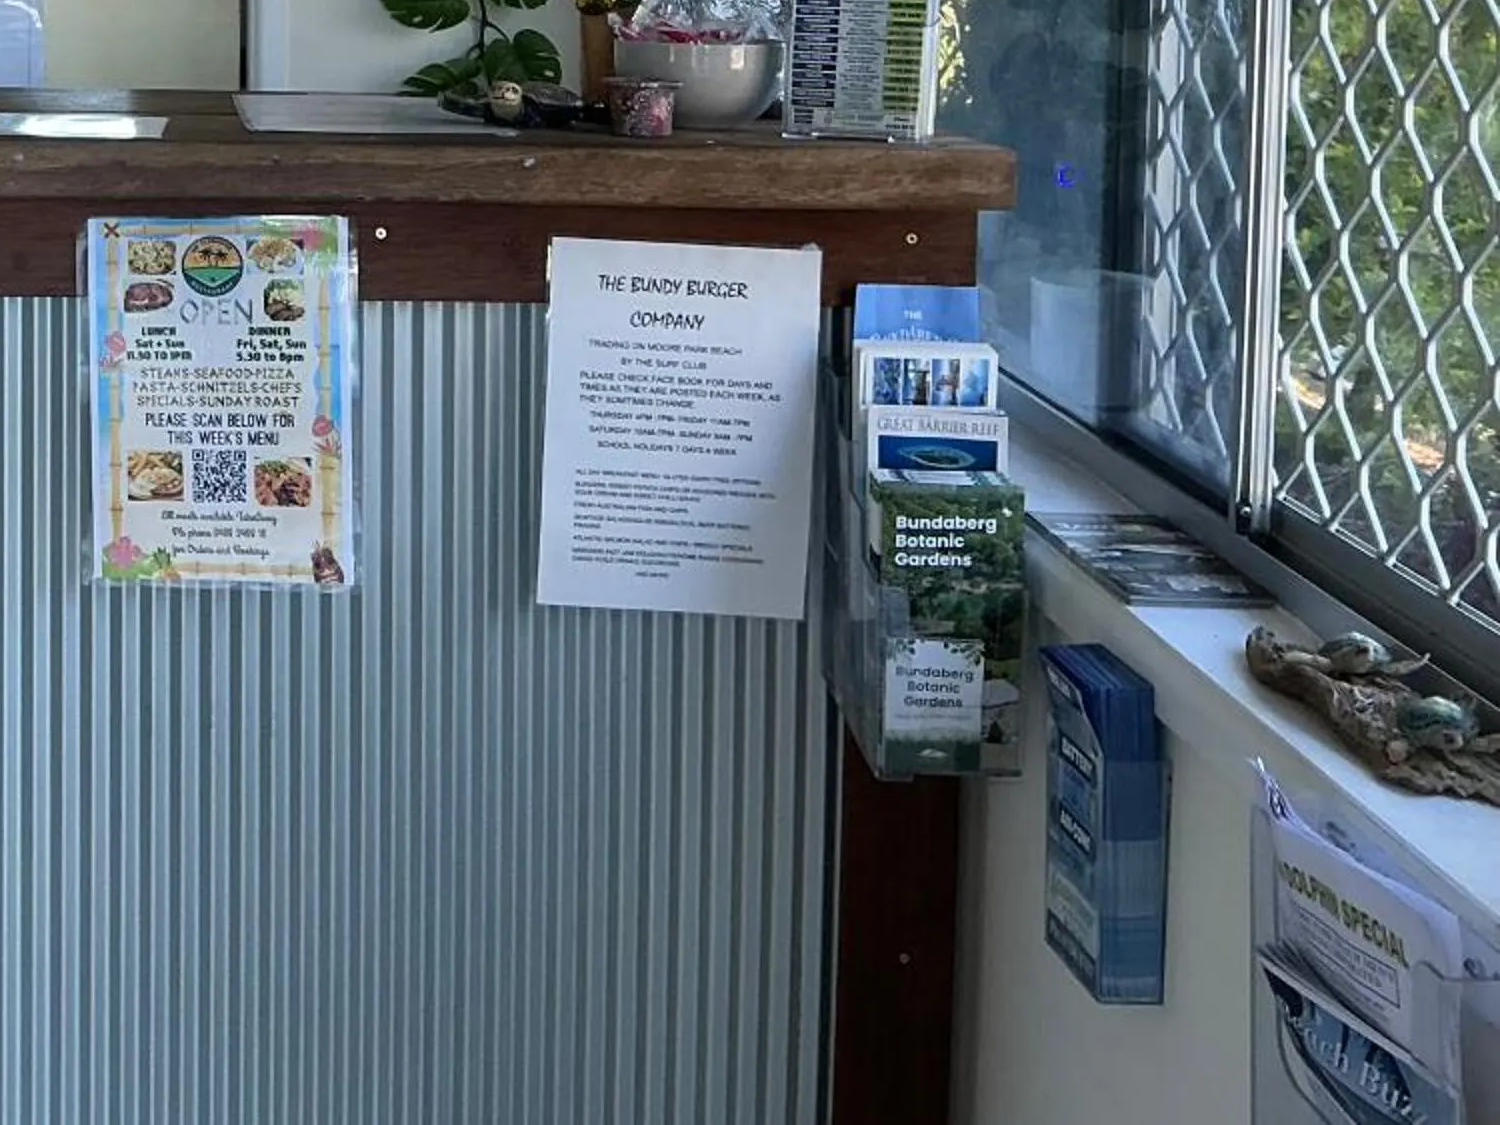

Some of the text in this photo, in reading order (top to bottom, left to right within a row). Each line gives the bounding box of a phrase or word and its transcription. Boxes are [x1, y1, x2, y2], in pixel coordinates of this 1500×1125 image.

[598, 275, 749, 300] THE BUNDY BURGER
[179, 297, 254, 326] OPEN
[903, 309, 923, 320] THE
[629, 310, 705, 331] COMPANY
[141, 326, 177, 336] LUNCH
[247, 326, 291, 336] DINNER
[135, 338, 154, 349] Sat
[165, 338, 185, 349] Sun
[236, 339, 307, 350] Fri, Sat, Sun
[589, 338, 743, 356] TRADING ON MOORE PARK BEACH
[154, 350, 169, 361] TO
[236, 351, 261, 362] 5.30
[263, 352, 277, 362] to
[621, 356, 708, 370] BY THE SURF CLUB
[579, 370, 774, 390] PLEASE CHECK FACE BOOK FOR DAYS AND
[579, 394, 604, 405] THEY
[624, 385, 649, 396] THEY
[649, 387, 668, 396] ARE
[669, 388, 708, 399] POSTED
[709, 390, 736, 400] EACH
[768, 393, 781, 403] AS
[254, 396, 300, 409] ROAST
[145, 412, 296, 428] PLEASE SCAN BELOW FOR
[590, 410, 633, 420] THURSDAY
[589, 425, 632, 434] SATURDAY
[877, 417, 1000, 436] GREAT BARRIER REEF
[168, 430, 280, 446] THIS WEEK'S MENU
[597, 440, 632, 450] SCHOOL
[633, 442, 674, 452] HOLIDAYS
[895, 515, 998, 534] Bundaberg
[895, 533, 965, 548] Botanic
[894, 552, 973, 567] Gardens
[896, 666, 975, 684] Bundaberg
[906, 680, 961, 694] Botanic
[903, 696, 964, 709] Gardens
[1339, 897, 1410, 969] SPECIAL
